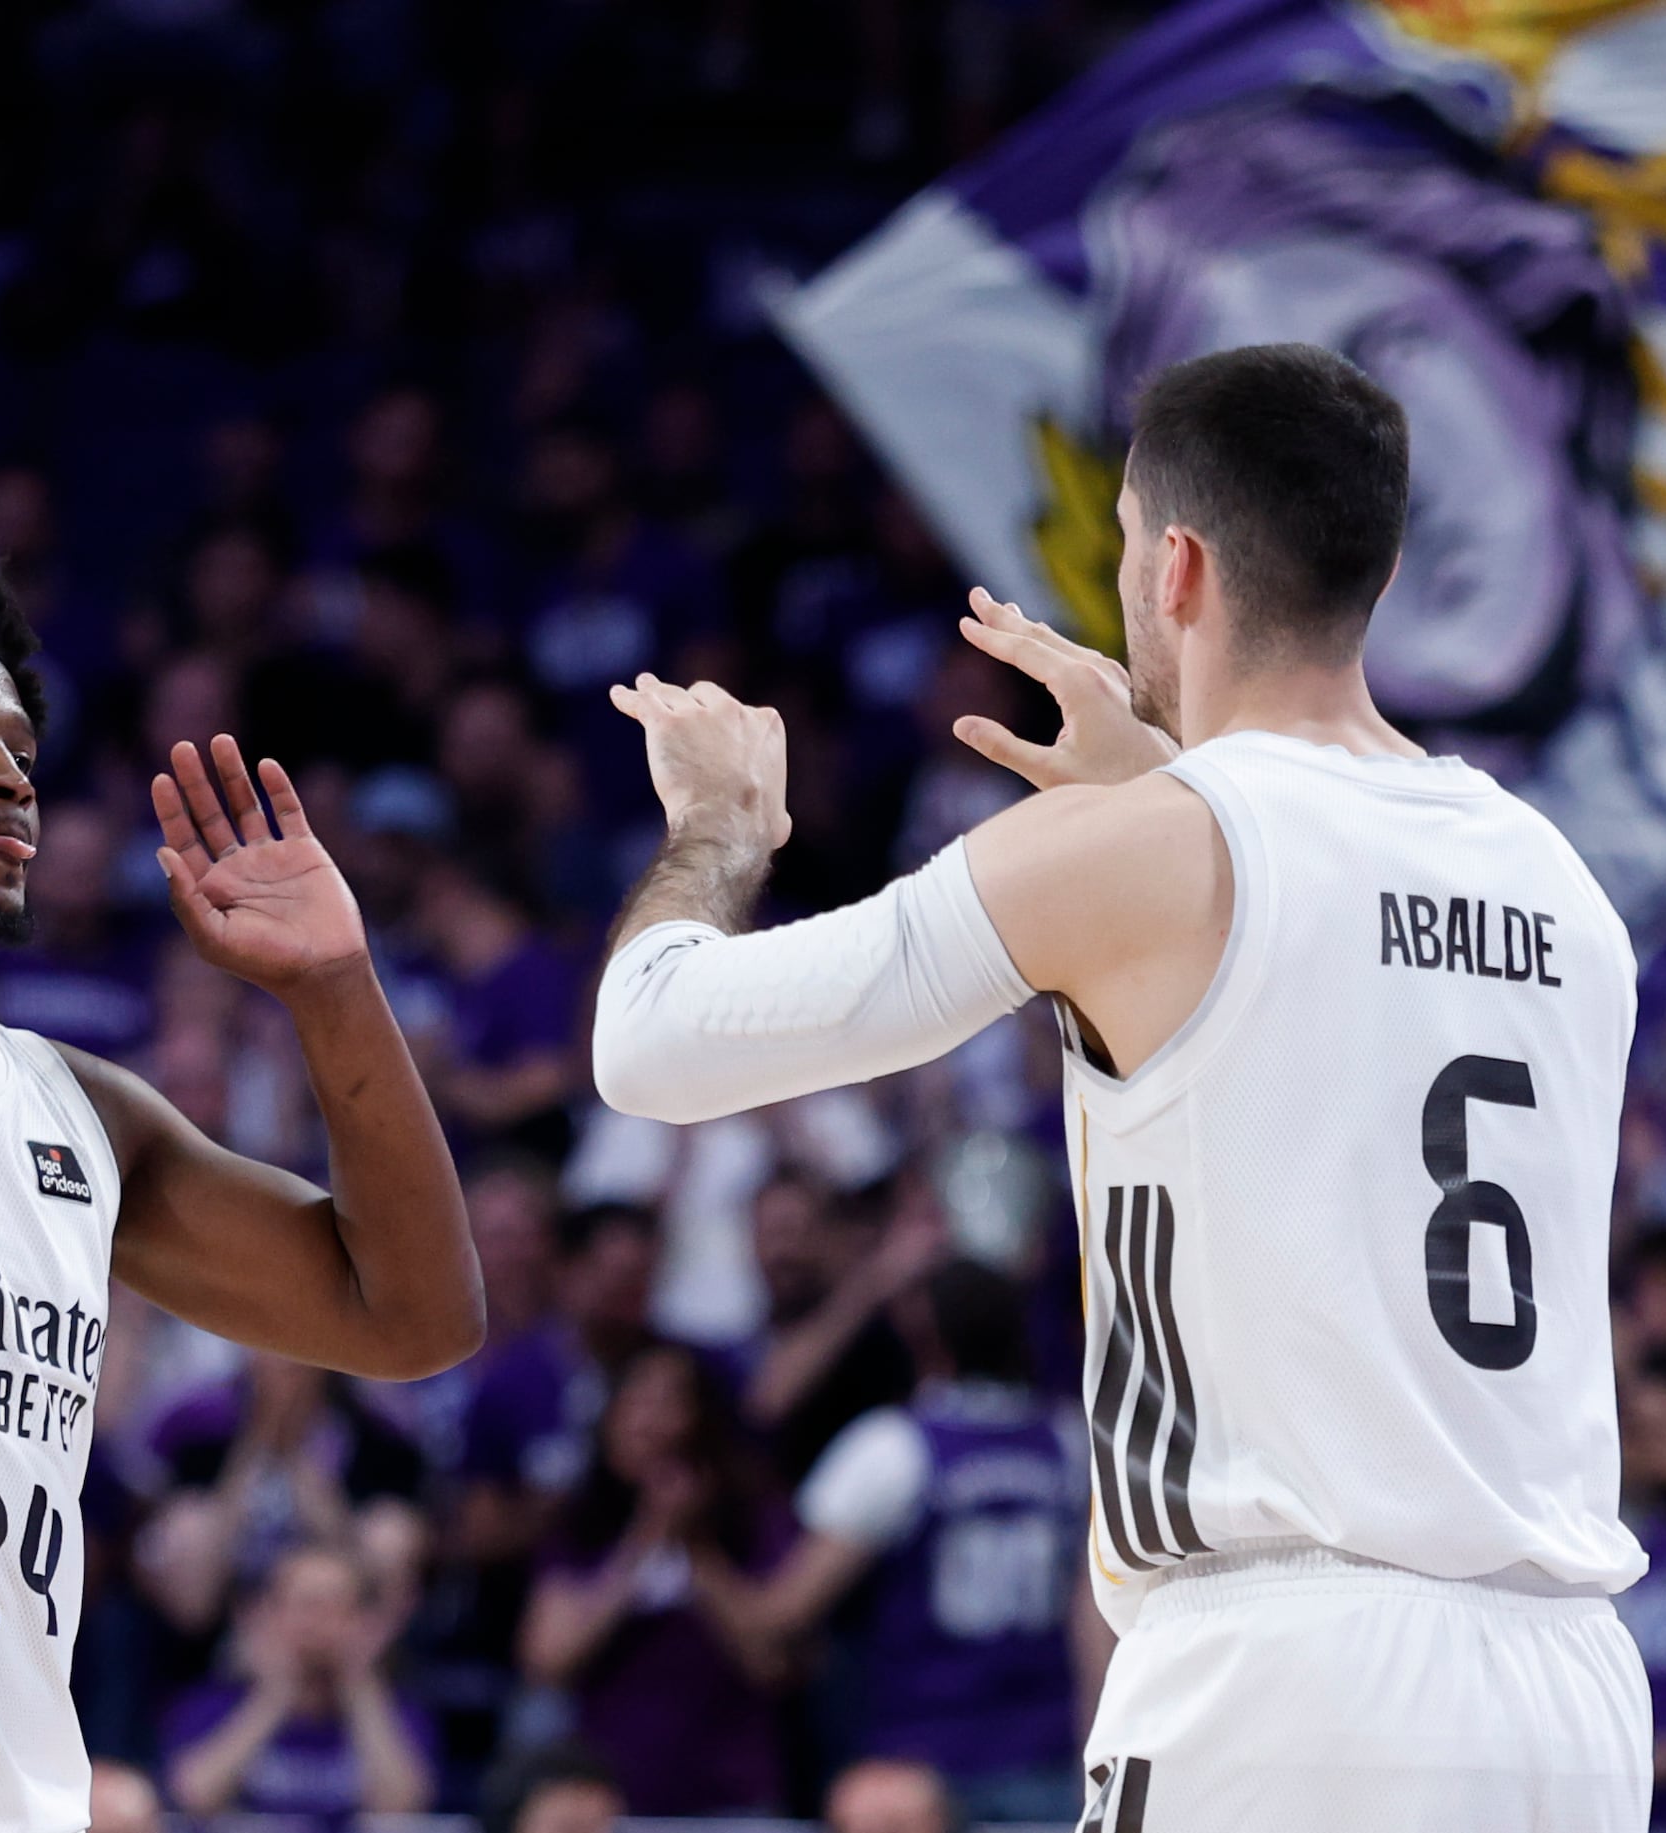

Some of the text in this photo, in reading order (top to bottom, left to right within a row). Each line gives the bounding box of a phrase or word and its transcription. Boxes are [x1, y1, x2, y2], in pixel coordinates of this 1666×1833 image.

[1379, 891, 1563, 989] ABALDE
[36, 1154, 63, 1176] liga
[41, 1175, 91, 1198] endesa
[1421, 1054, 1538, 1371] 6
